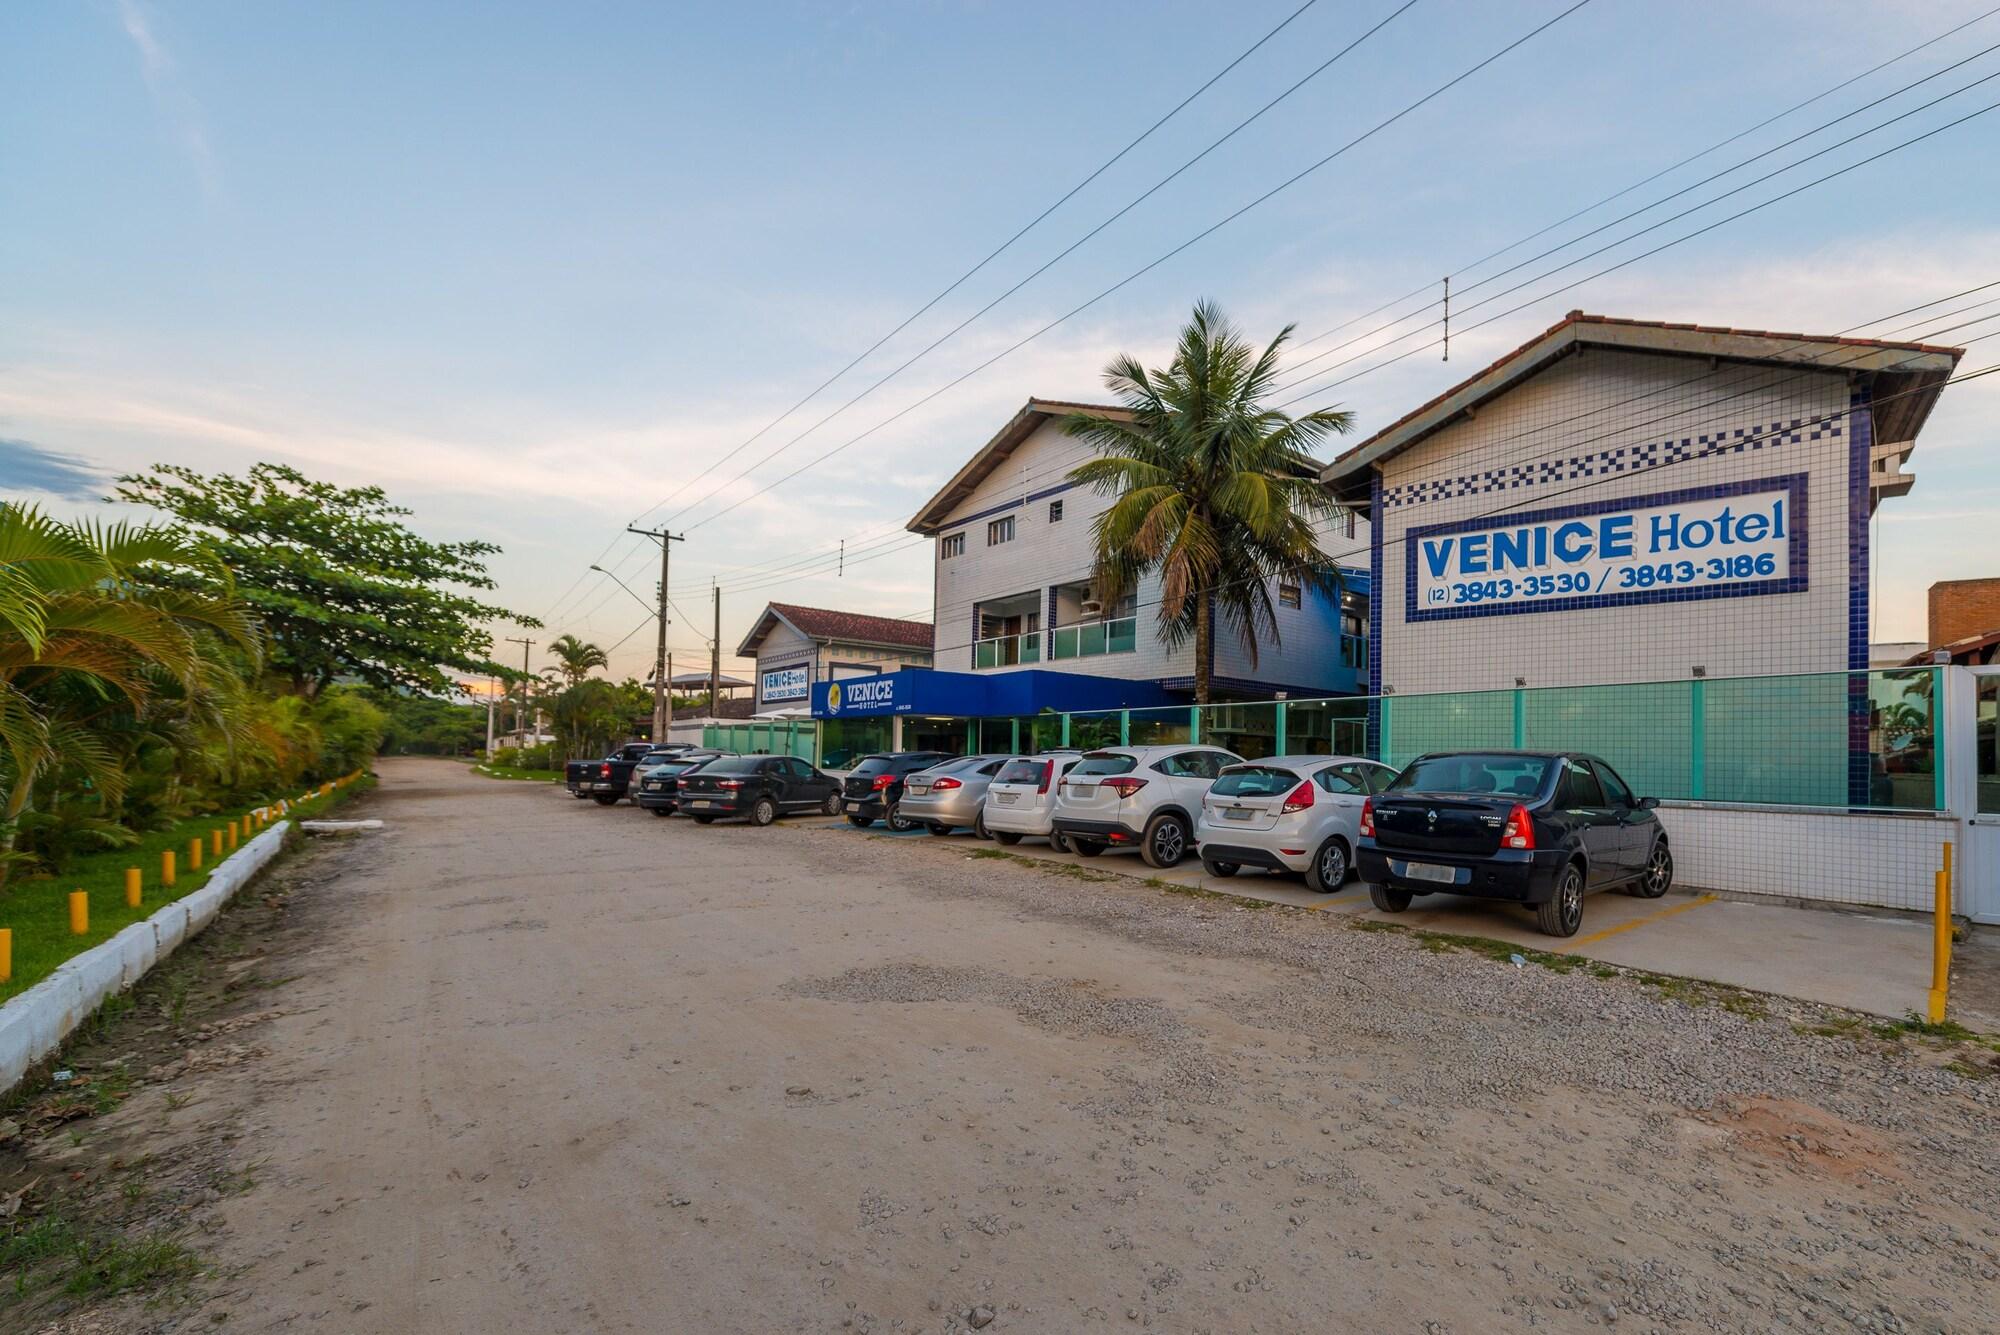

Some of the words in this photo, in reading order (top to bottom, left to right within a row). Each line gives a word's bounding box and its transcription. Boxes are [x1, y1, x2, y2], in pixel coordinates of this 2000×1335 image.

[1423, 515, 1637, 581] VENICE
[1649, 500, 1785, 553] Hotel
[1428, 586, 1450, 605] (12)
[1452, 571, 1591, 603] 3843-3530
[1619, 553, 1776, 588] 3843-3186
[764, 672, 791, 689] VENICE
[847, 680, 894, 702] VENICE
[859, 701, 878, 710] HOTEL
